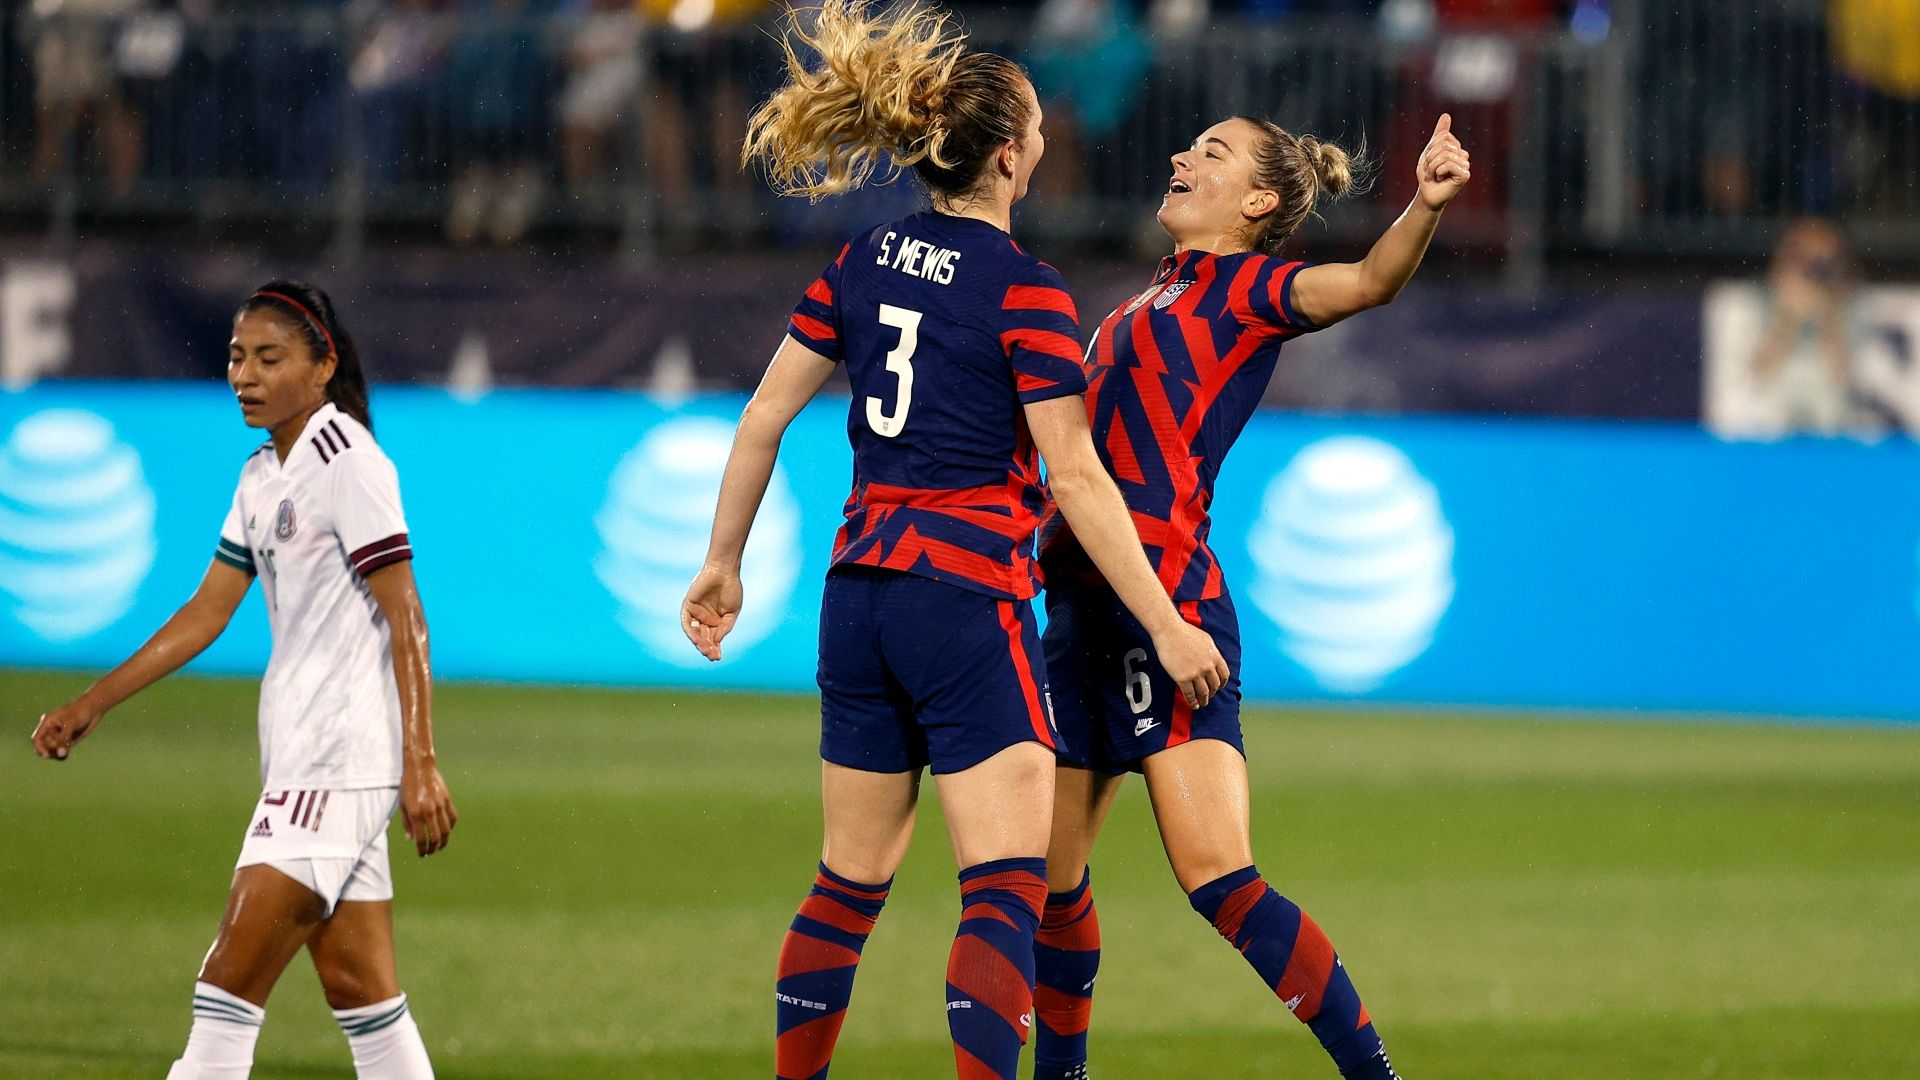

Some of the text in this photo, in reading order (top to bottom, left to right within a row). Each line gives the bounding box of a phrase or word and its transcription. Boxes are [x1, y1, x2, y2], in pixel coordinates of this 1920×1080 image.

[876, 231, 962, 286] S. MEWIS
[865, 303, 924, 438] 3
[1123, 648, 1152, 715] 6
[1137, 717, 1154, 729] NIKE
